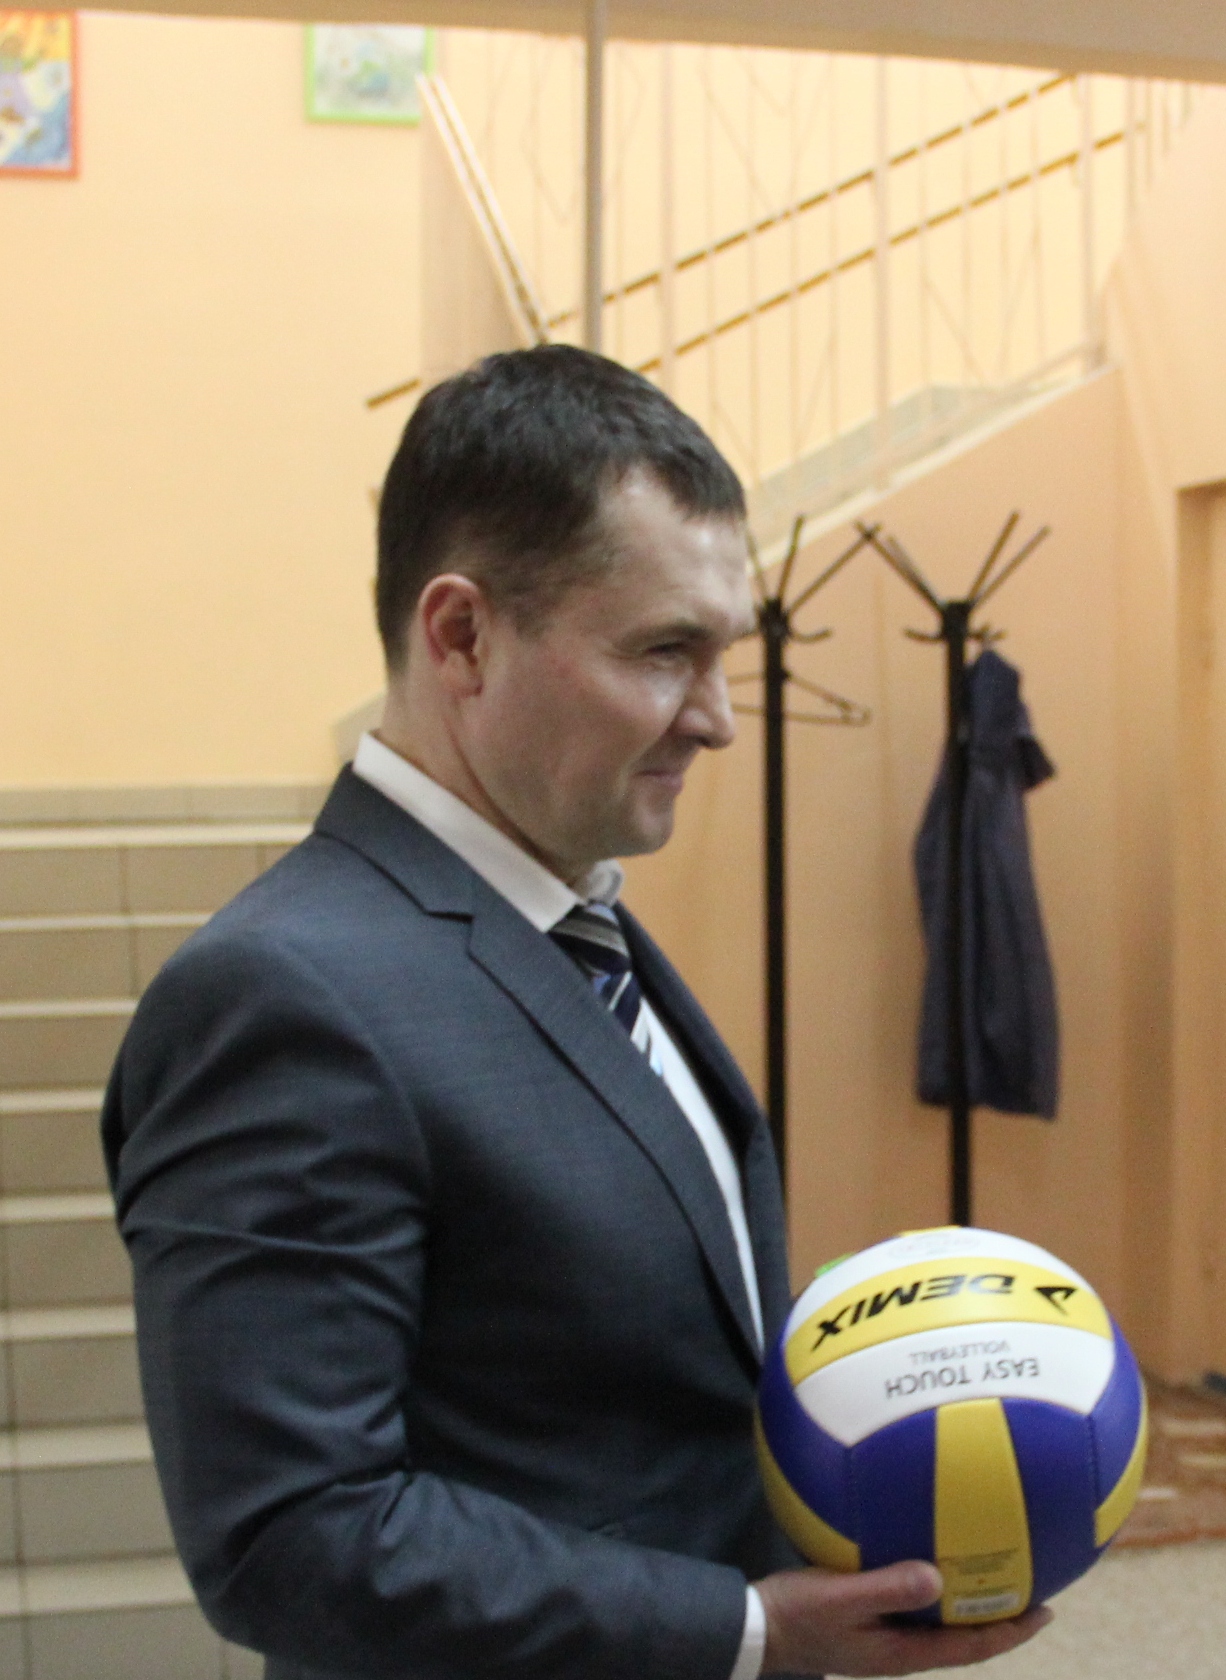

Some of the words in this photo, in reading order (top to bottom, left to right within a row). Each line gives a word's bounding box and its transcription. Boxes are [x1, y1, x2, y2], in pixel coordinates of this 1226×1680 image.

[812, 1273, 1015, 1351] DEMIX
[909, 1340, 1011, 1364] VOLLEYBALL
[884, 1367, 972, 1399] TOUCH
[981, 1358, 1039, 1382] EASY
